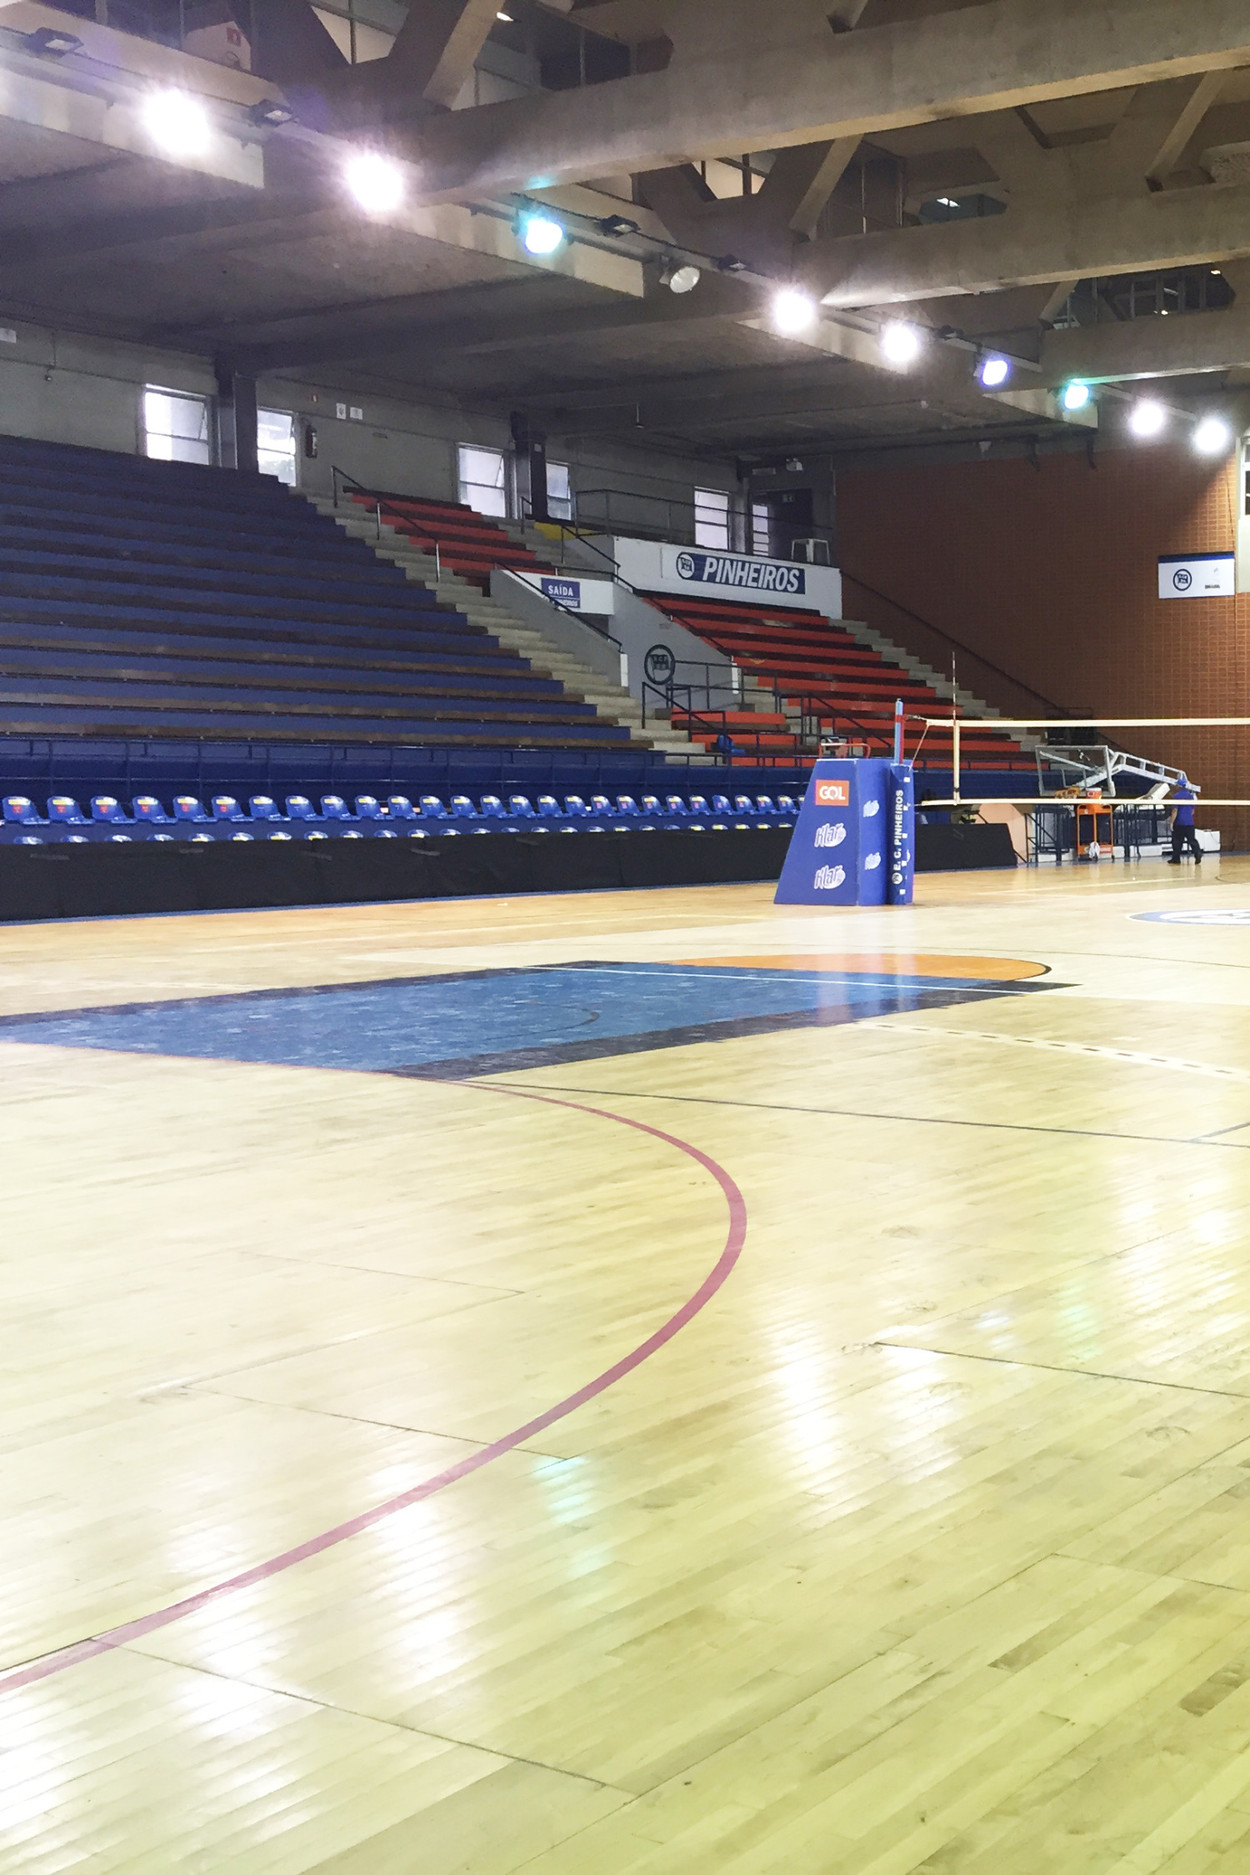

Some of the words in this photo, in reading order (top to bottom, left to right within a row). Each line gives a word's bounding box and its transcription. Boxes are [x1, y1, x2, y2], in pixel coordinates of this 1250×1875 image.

[702, 556, 800, 592] PINHEIROS
[547, 584, 574, 597] SAÍDA
[819, 785, 846, 801] GOL
[894, 789, 904, 846] PINHEIROS
